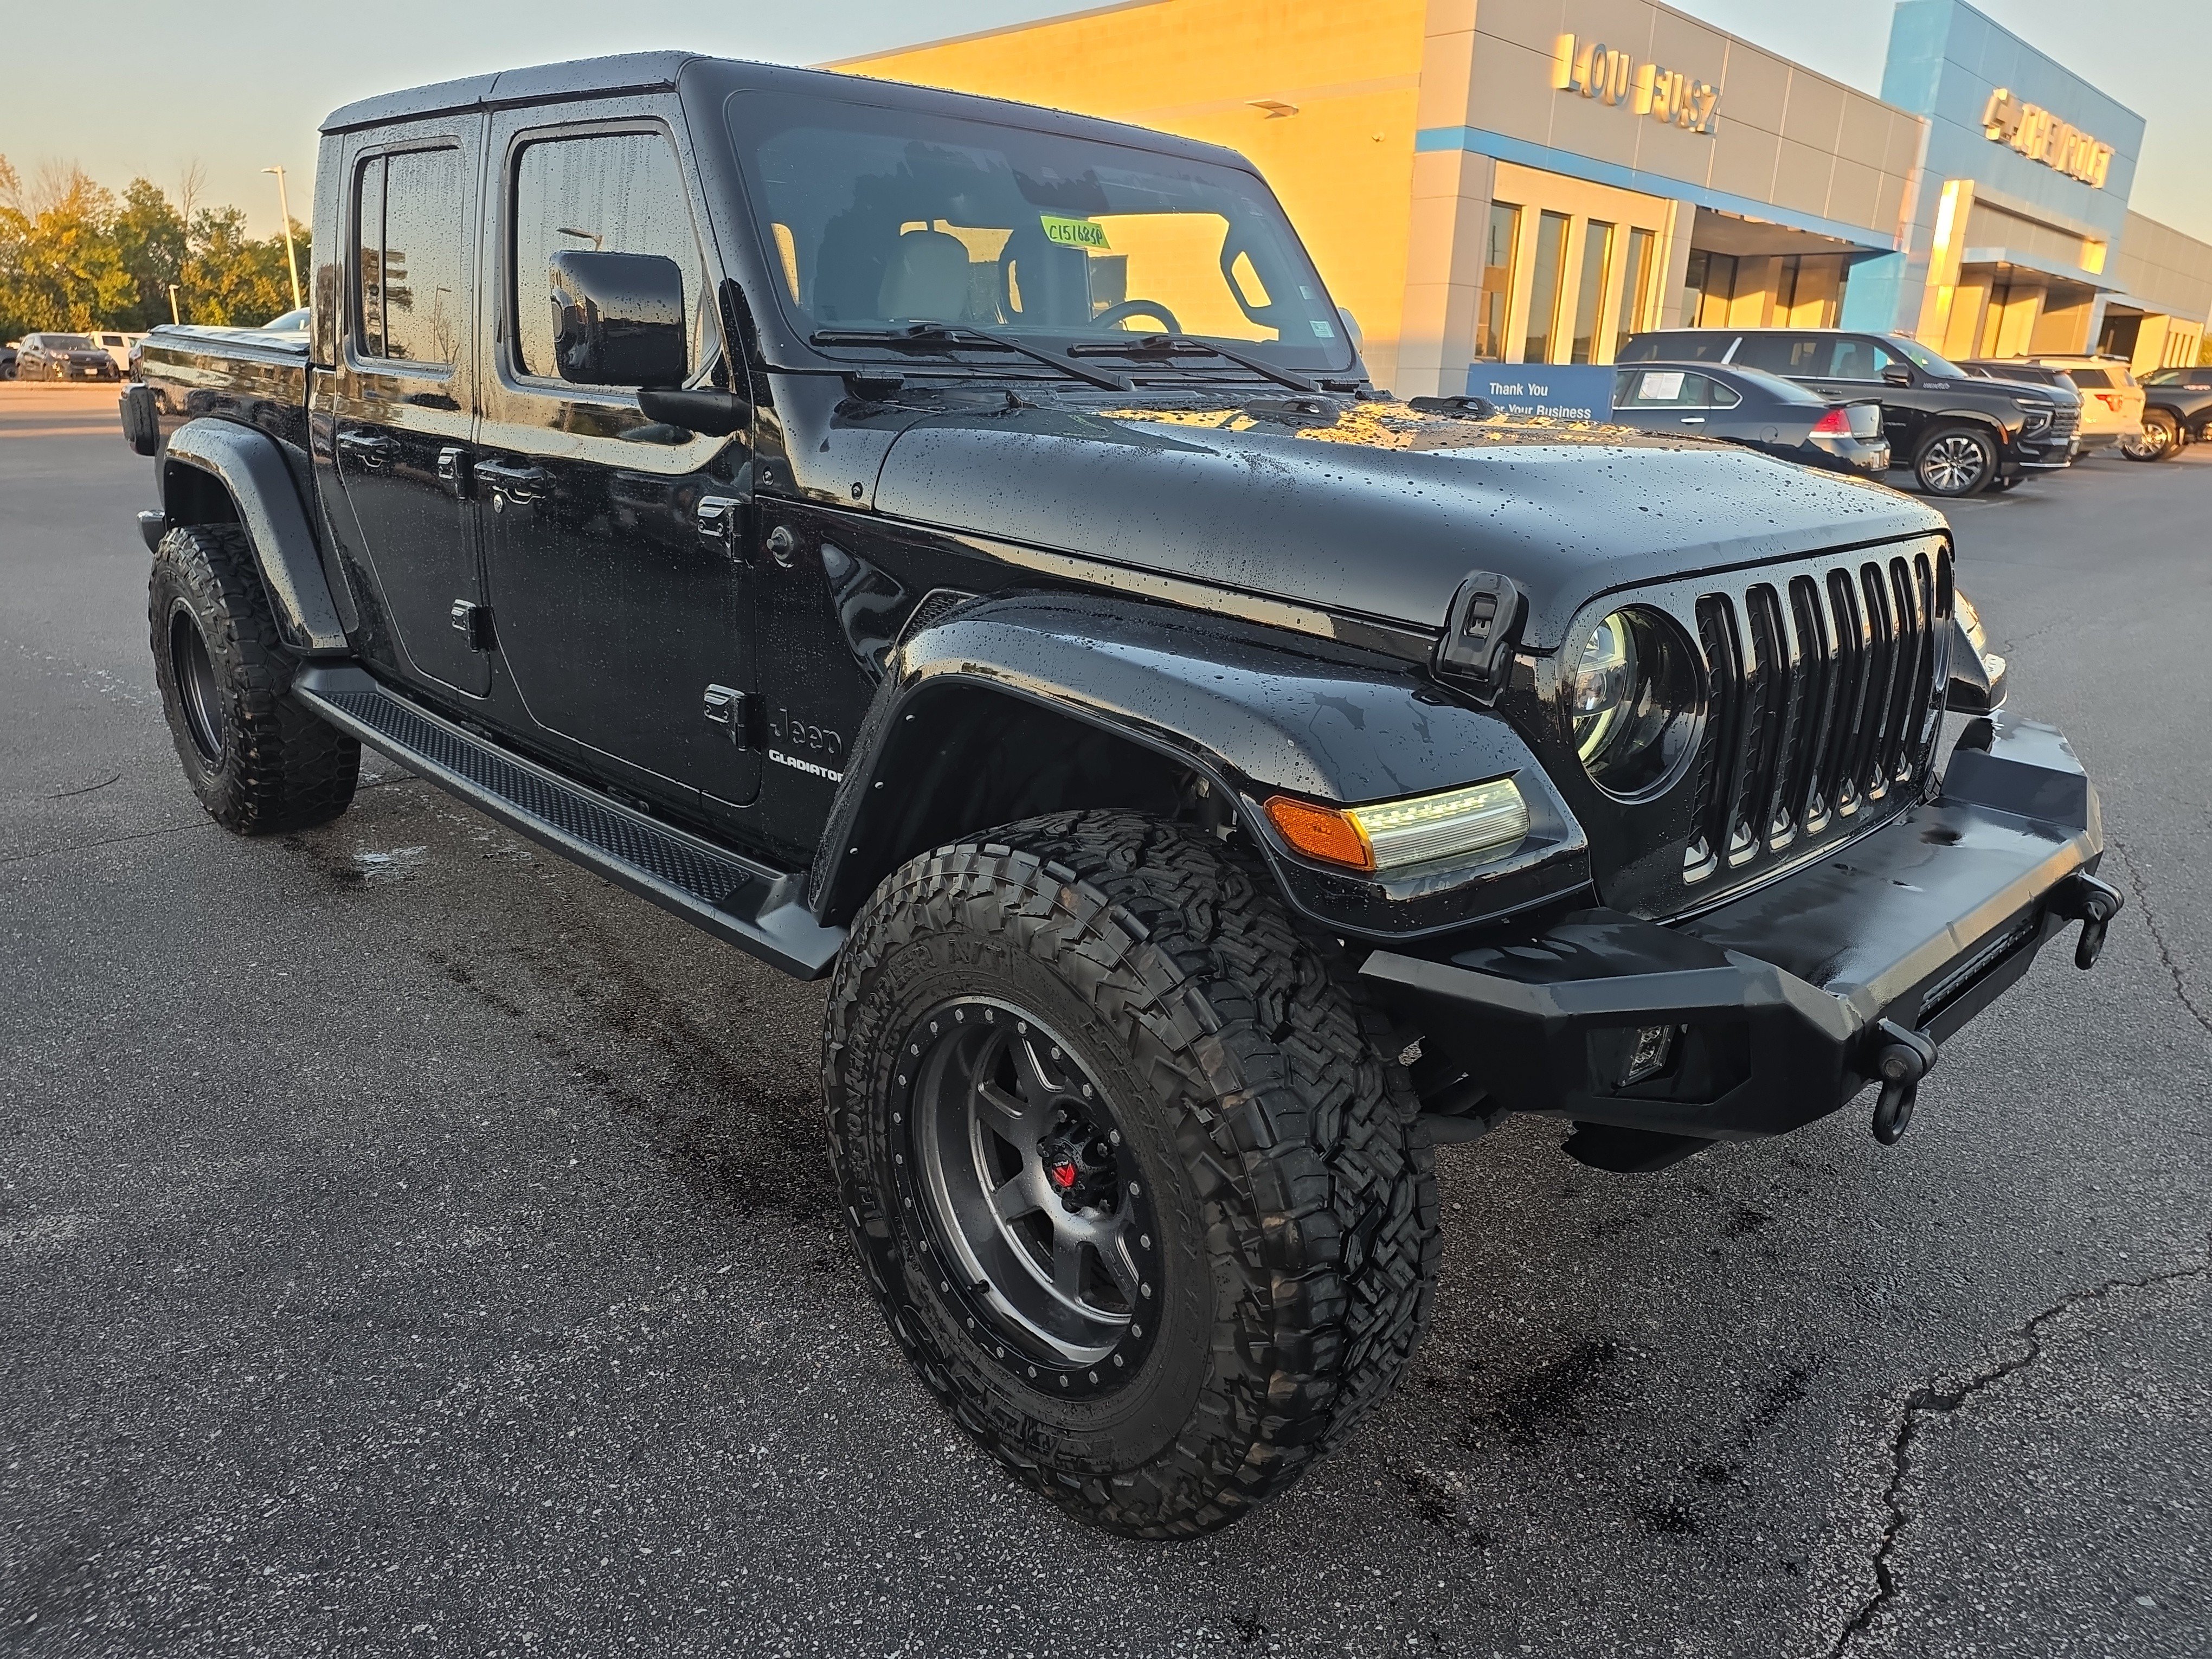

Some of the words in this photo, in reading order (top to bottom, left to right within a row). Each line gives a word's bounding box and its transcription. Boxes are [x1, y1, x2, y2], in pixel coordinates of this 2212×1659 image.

[1553, 34, 1632, 106] LOU
[1635, 64, 1721, 134] FUSZ
[1489, 382, 1523, 396] Thank
[1528, 383, 1548, 396] You
[1508, 403, 1533, 415] Your
[1536, 404, 1592, 419] Business
[769, 708, 844, 766] Jeep
